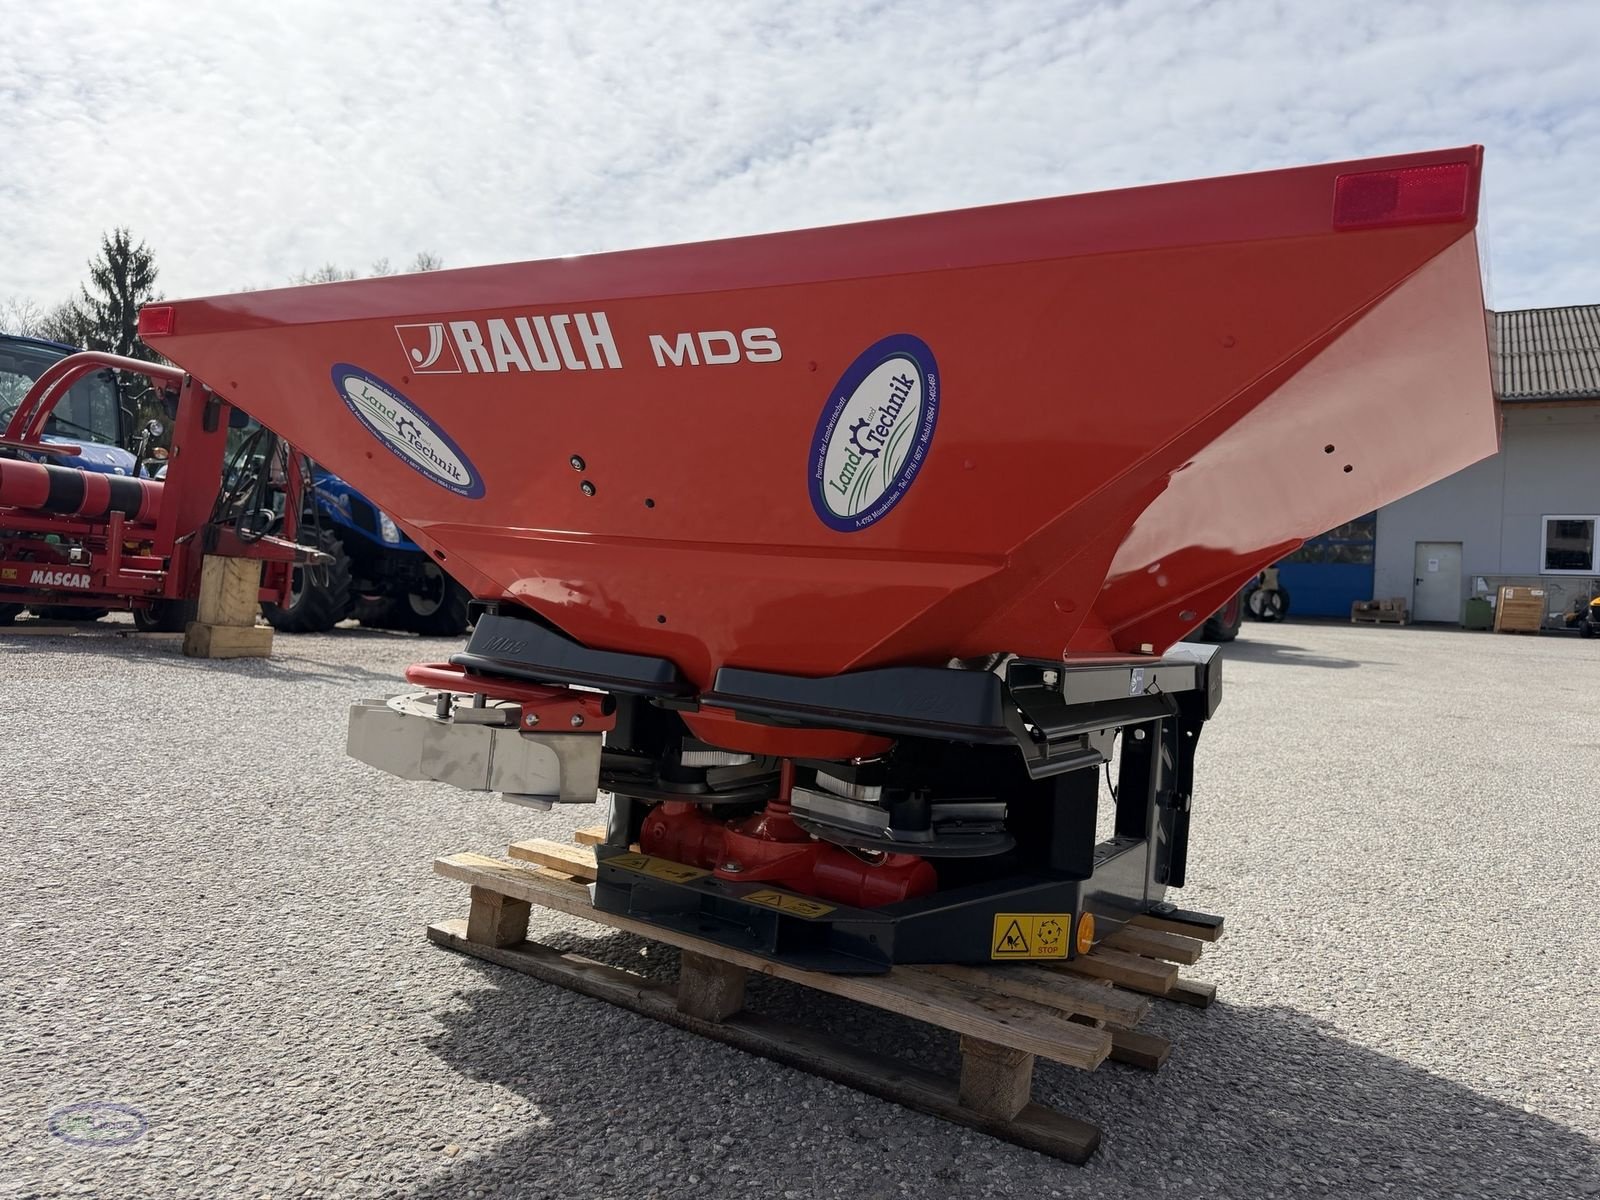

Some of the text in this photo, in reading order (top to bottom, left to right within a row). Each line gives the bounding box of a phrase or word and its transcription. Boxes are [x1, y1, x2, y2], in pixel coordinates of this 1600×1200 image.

[449, 311, 623, 374] RAUCH
[649, 327, 782, 367] MDS
[361, 386, 397, 422] Land
[866, 373, 915, 446] Technik
[867, 407, 876, 422] und
[408, 431, 461, 481] Technik
[819, 443, 827, 456] der
[829, 447, 862, 495] Land
[30, 570, 91, 589] MASCAR
[1038, 946, 1058, 954] STOP
